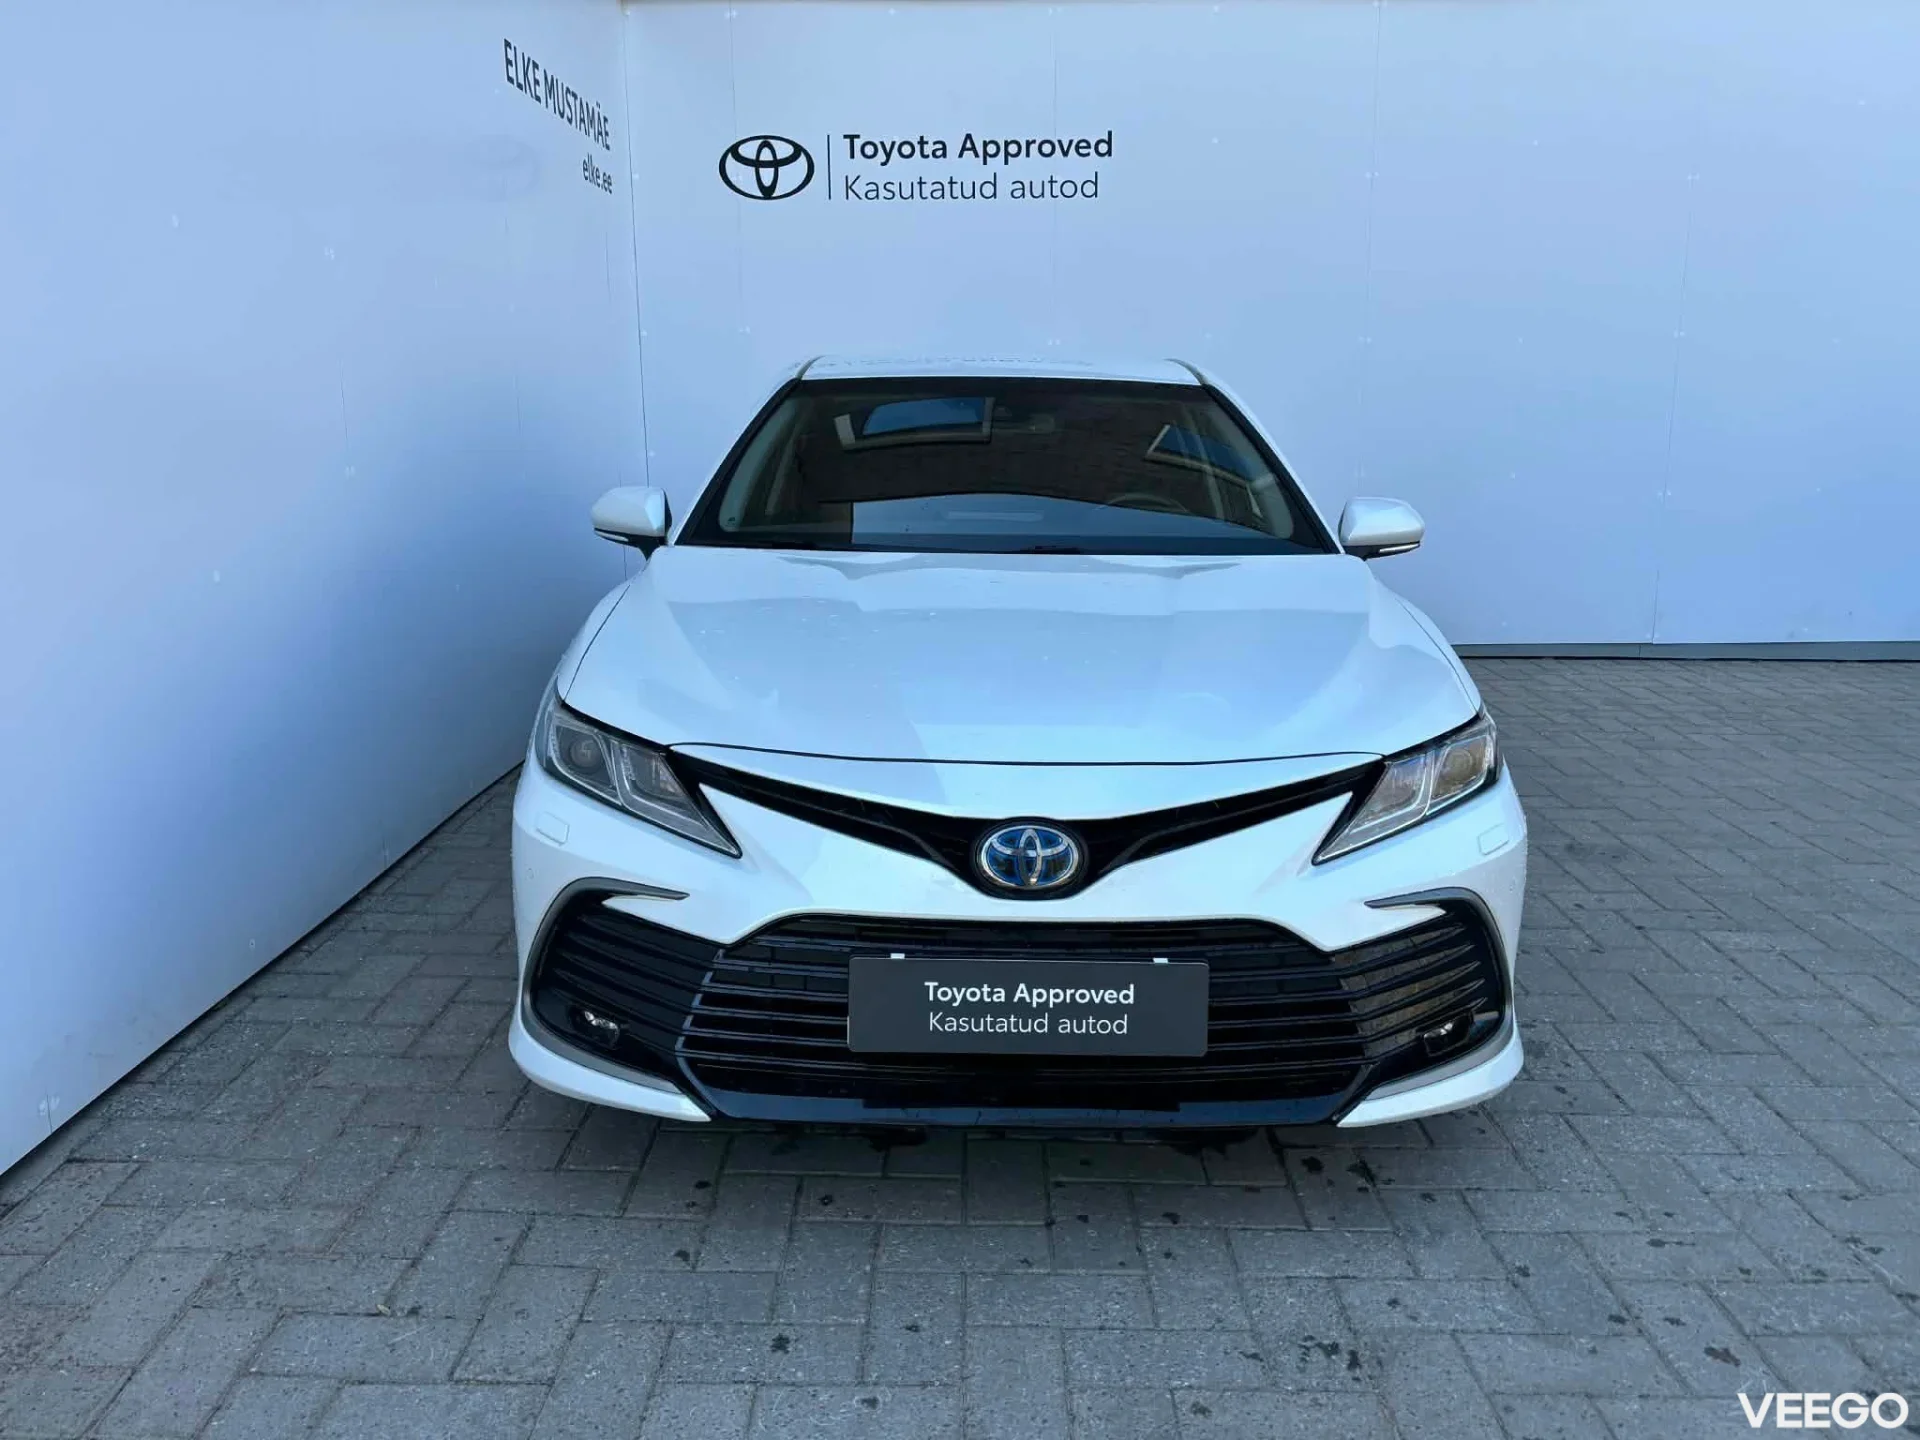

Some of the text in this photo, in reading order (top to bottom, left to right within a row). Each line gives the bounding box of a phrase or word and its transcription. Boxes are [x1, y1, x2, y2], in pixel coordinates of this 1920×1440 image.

[504, 38, 610, 151] ELKE MUSTAMÄE
[843, 130, 1113, 166] Toyota Approved
[582, 152, 613, 194] elke.ee
[844, 171, 1099, 201] Kasutatud autod
[924, 981, 1135, 1009] Toyota Approved
[929, 1011, 1128, 1035] Kasutatud autod
